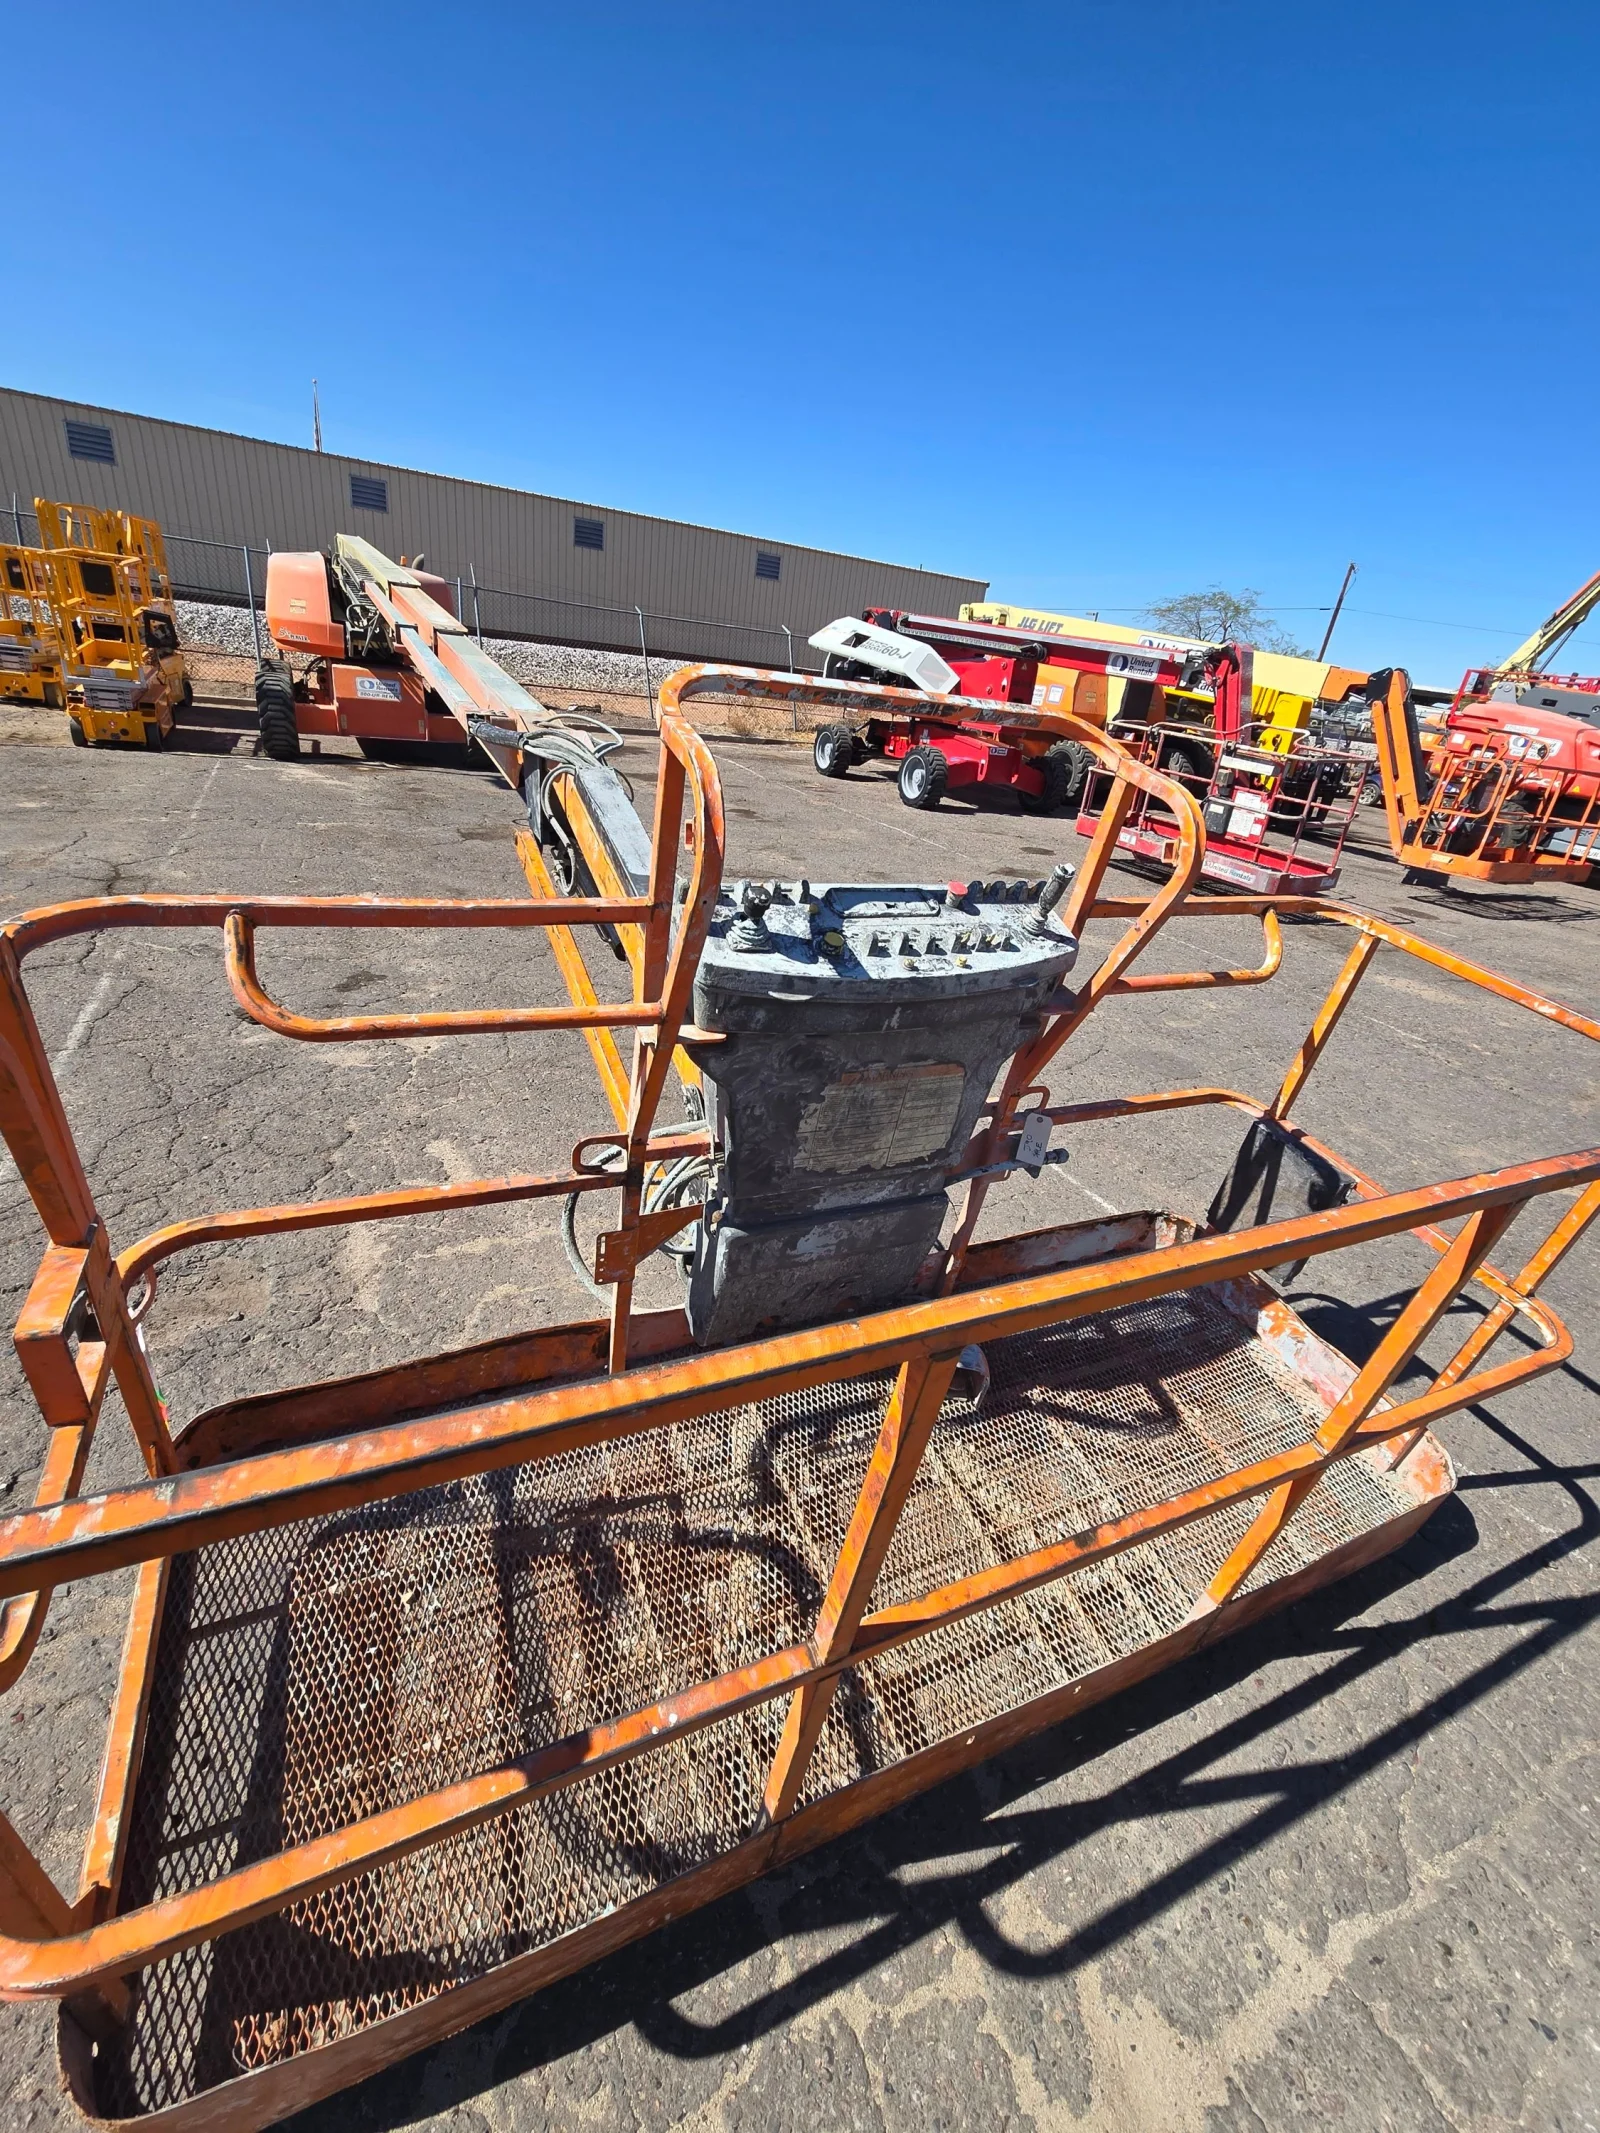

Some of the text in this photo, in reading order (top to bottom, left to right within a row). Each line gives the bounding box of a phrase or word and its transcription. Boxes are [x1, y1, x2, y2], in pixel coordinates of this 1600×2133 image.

[1017, 616, 1064, 634] JLG LIFT
[881, 645, 912, 659] 60-J
[1130, 656, 1154, 668] United
[1127, 666, 1154, 676] Rentals
[1209, 861, 1252, 881] United Rentals
